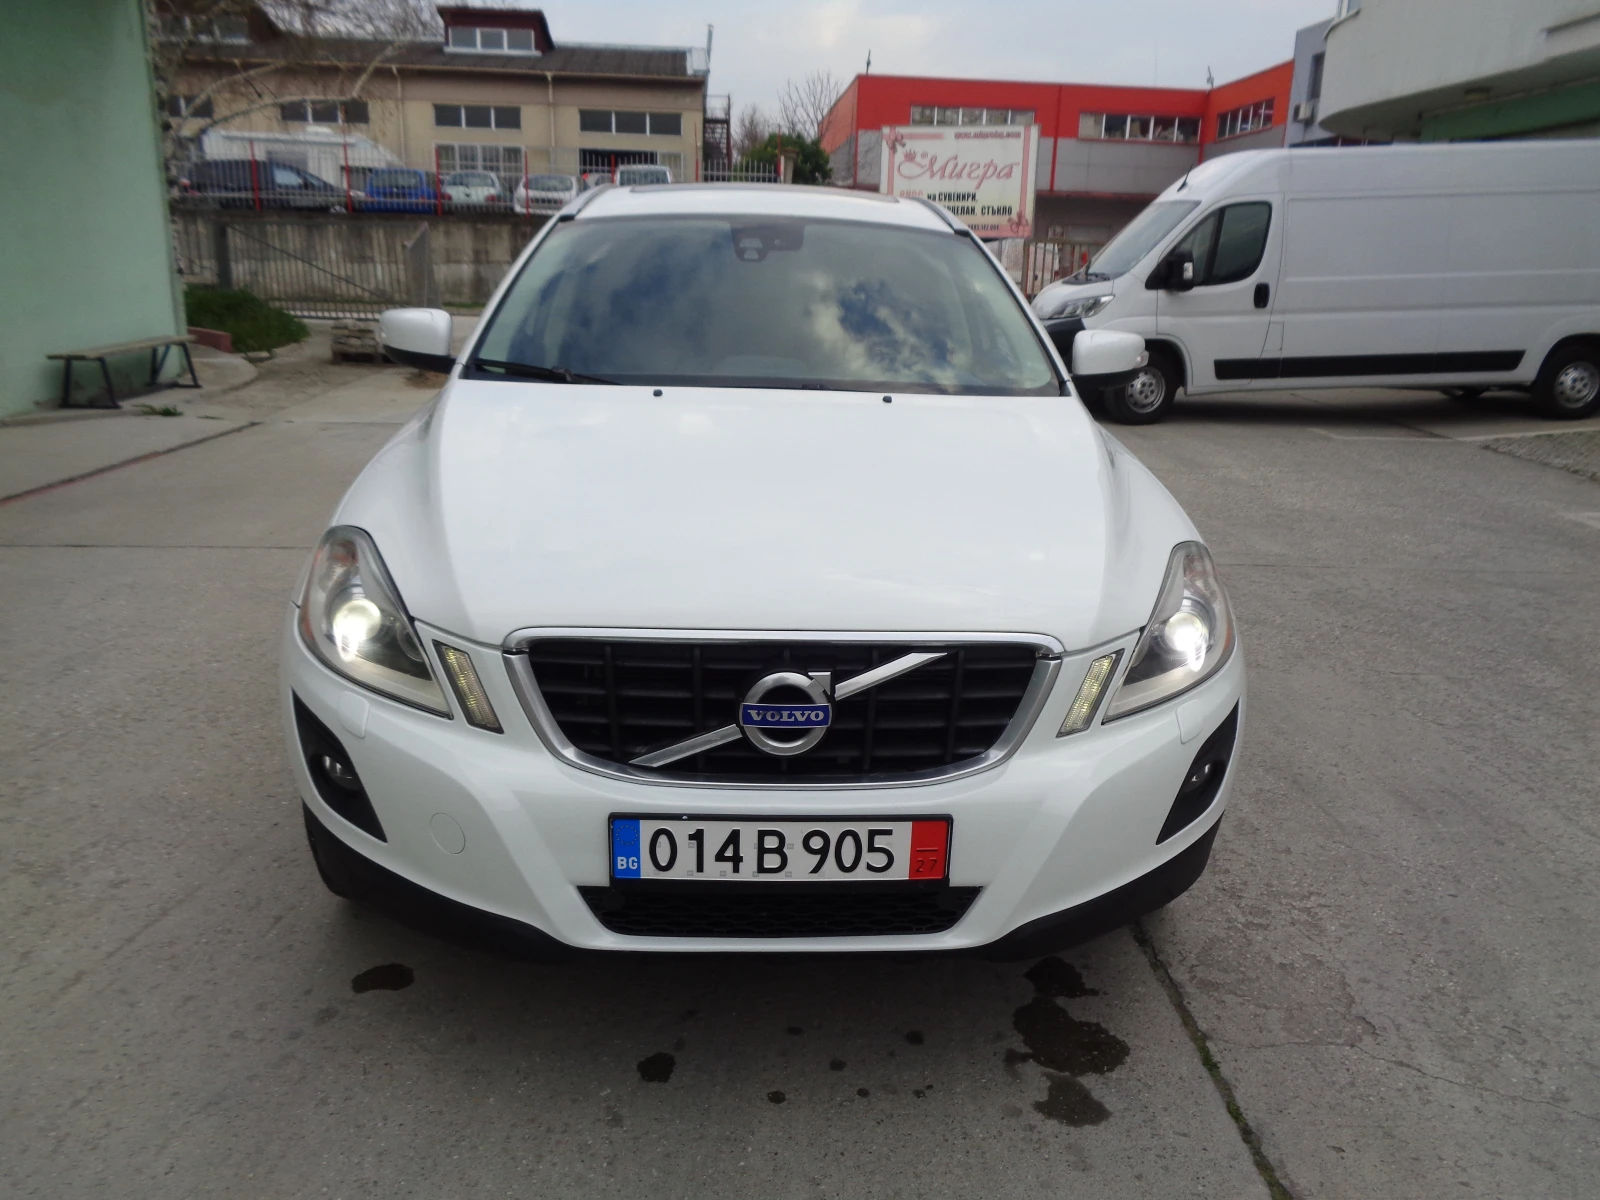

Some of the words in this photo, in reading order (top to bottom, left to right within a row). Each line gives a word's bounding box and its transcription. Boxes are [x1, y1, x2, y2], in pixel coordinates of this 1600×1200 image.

[897, 154, 1021, 190] Мигра
[747, 709, 825, 722] VOLVO
[648, 827, 744, 873] 014
[756, 829, 789, 874] B
[802, 828, 895, 874] 905
[617, 856, 638, 870] BG
[915, 857, 938, 873] 27
